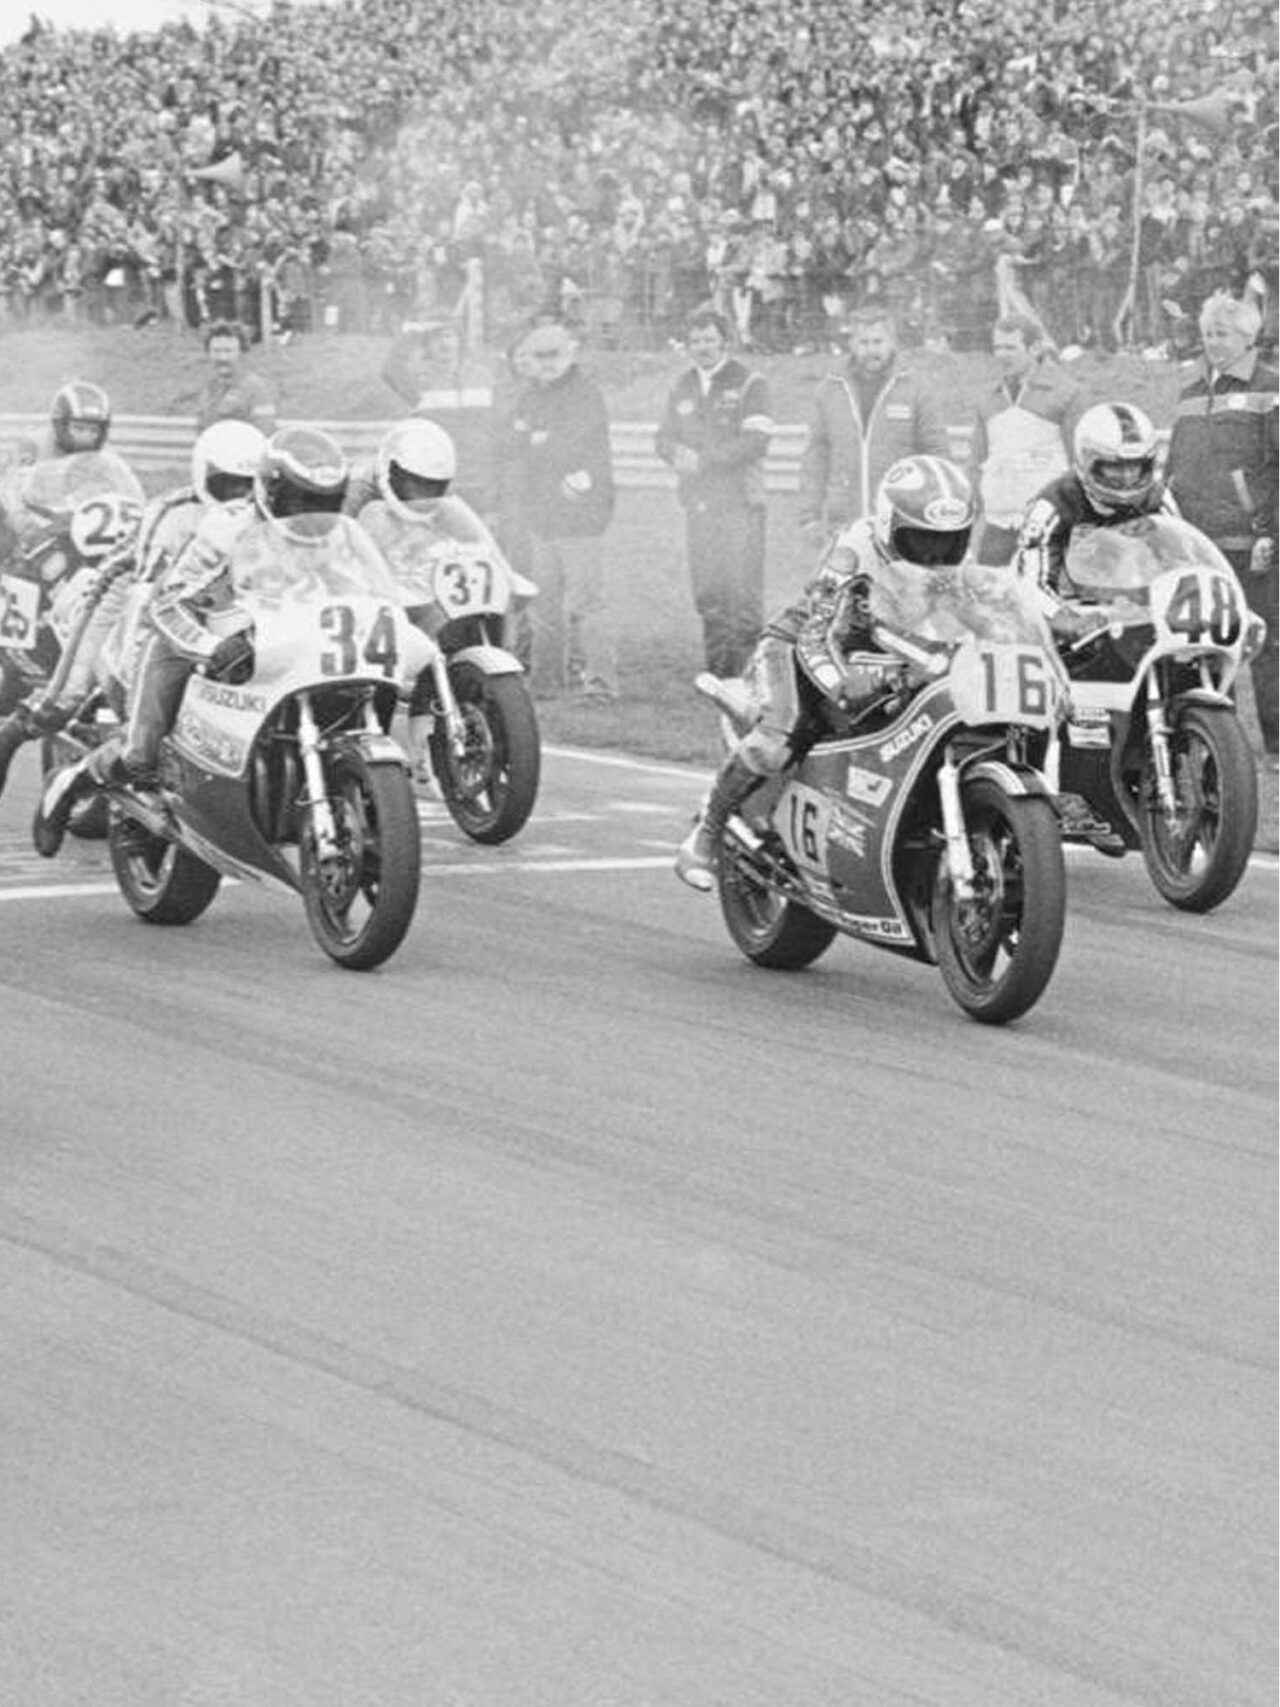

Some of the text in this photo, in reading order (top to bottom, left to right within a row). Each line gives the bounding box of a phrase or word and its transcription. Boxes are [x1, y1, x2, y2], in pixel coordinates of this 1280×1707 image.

[81, 501, 142, 547] 25
[444, 561, 492, 606] 37
[1166, 573, 1241, 646] 48
[320, 605, 398, 679] 34
[981, 652, 1047, 716] 16
[791, 794, 819, 863] 16
